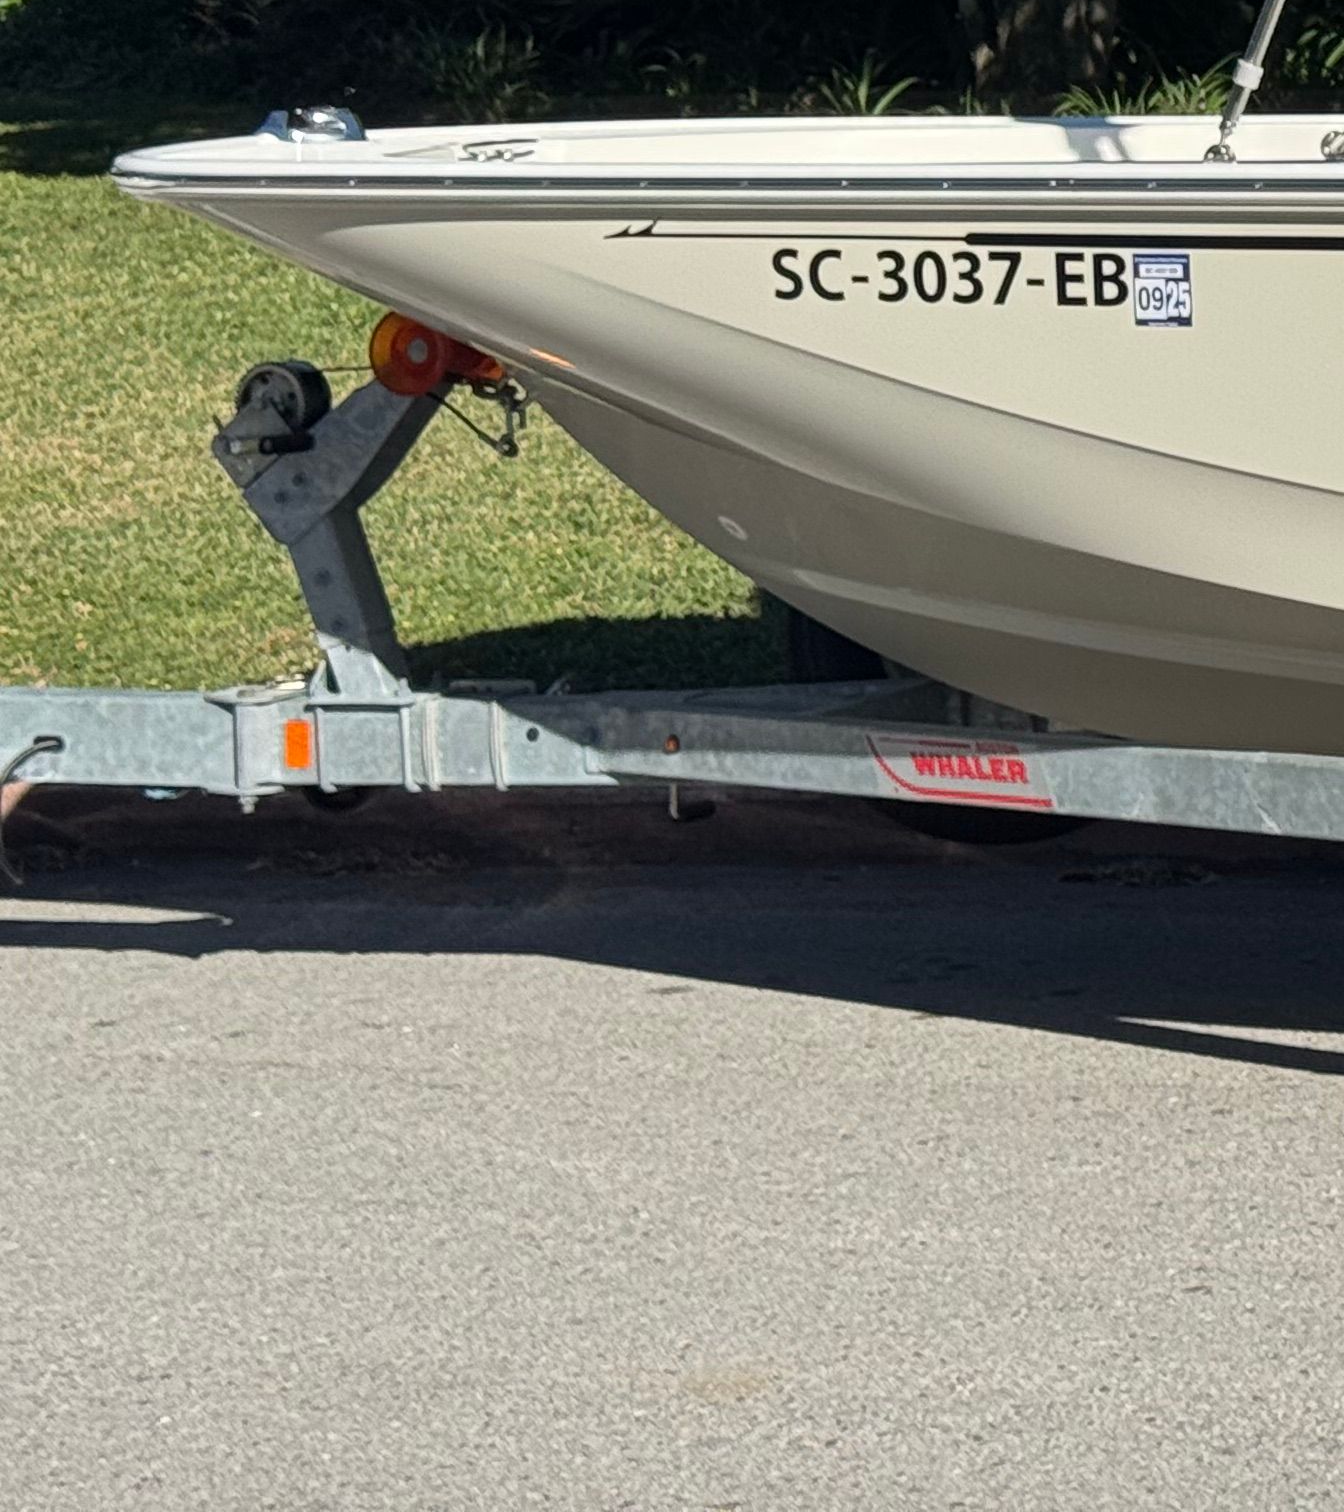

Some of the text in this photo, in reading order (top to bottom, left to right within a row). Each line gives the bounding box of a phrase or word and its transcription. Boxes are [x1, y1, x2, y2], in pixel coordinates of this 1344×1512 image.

[772, 248, 1129, 307] SC-3037-EB
[1138, 286, 1164, 311] 09
[909, 752, 1029, 784] WHALER
